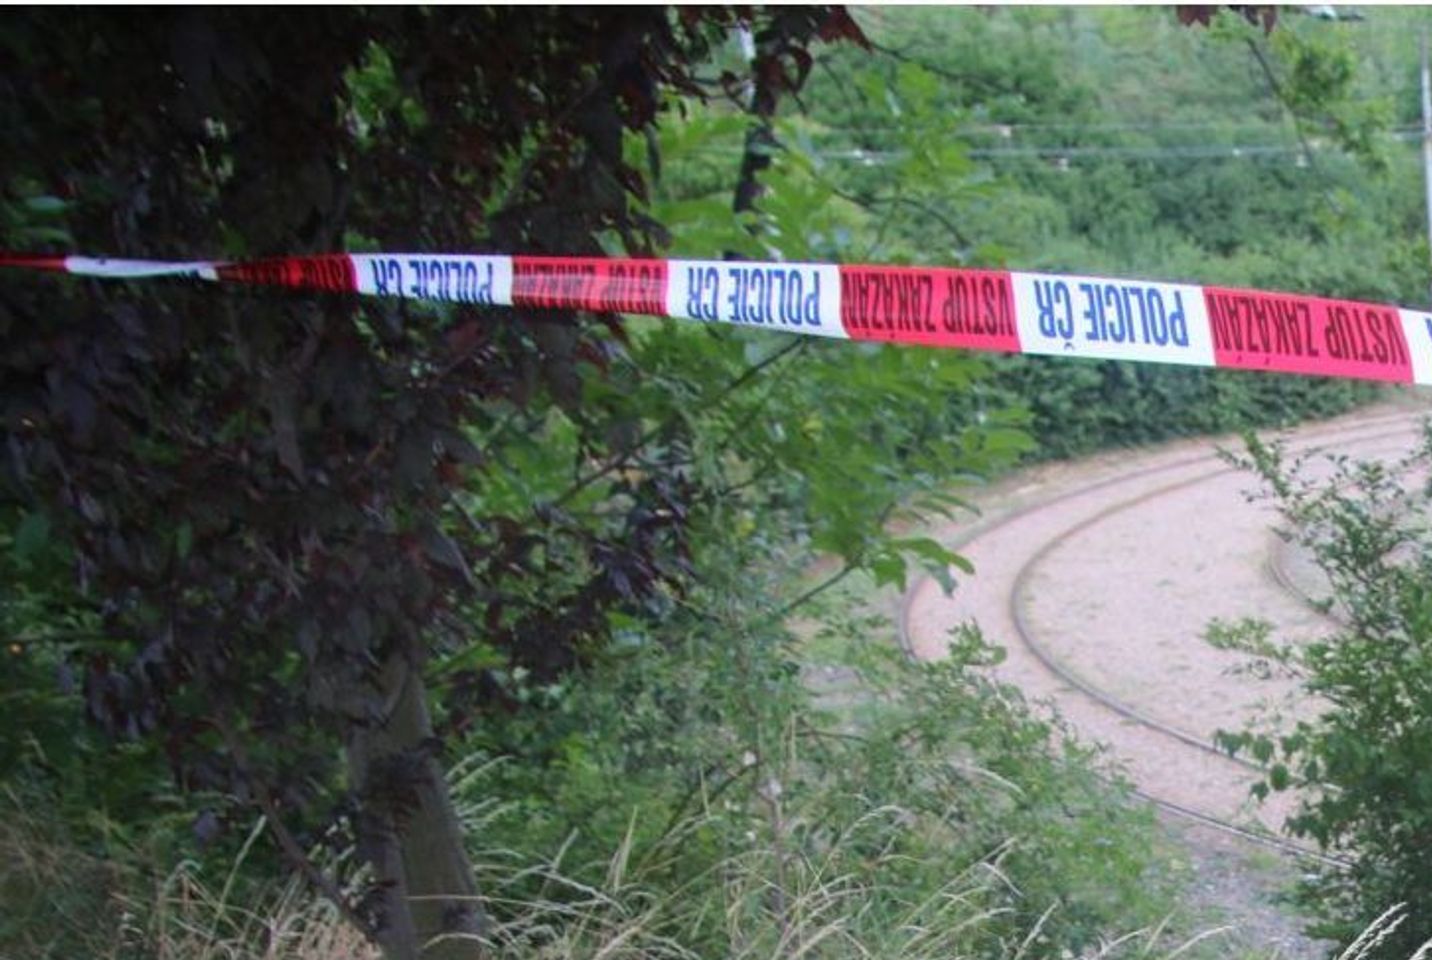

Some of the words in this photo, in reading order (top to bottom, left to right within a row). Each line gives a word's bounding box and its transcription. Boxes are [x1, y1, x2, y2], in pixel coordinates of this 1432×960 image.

[728, 268, 821, 326] POLICIE
[943, 276, 1014, 337] VSTUP
[1033, 279, 1075, 351] ČR
[1078, 283, 1189, 347] POLICIE
[1325, 306, 1407, 365] VSTUP
